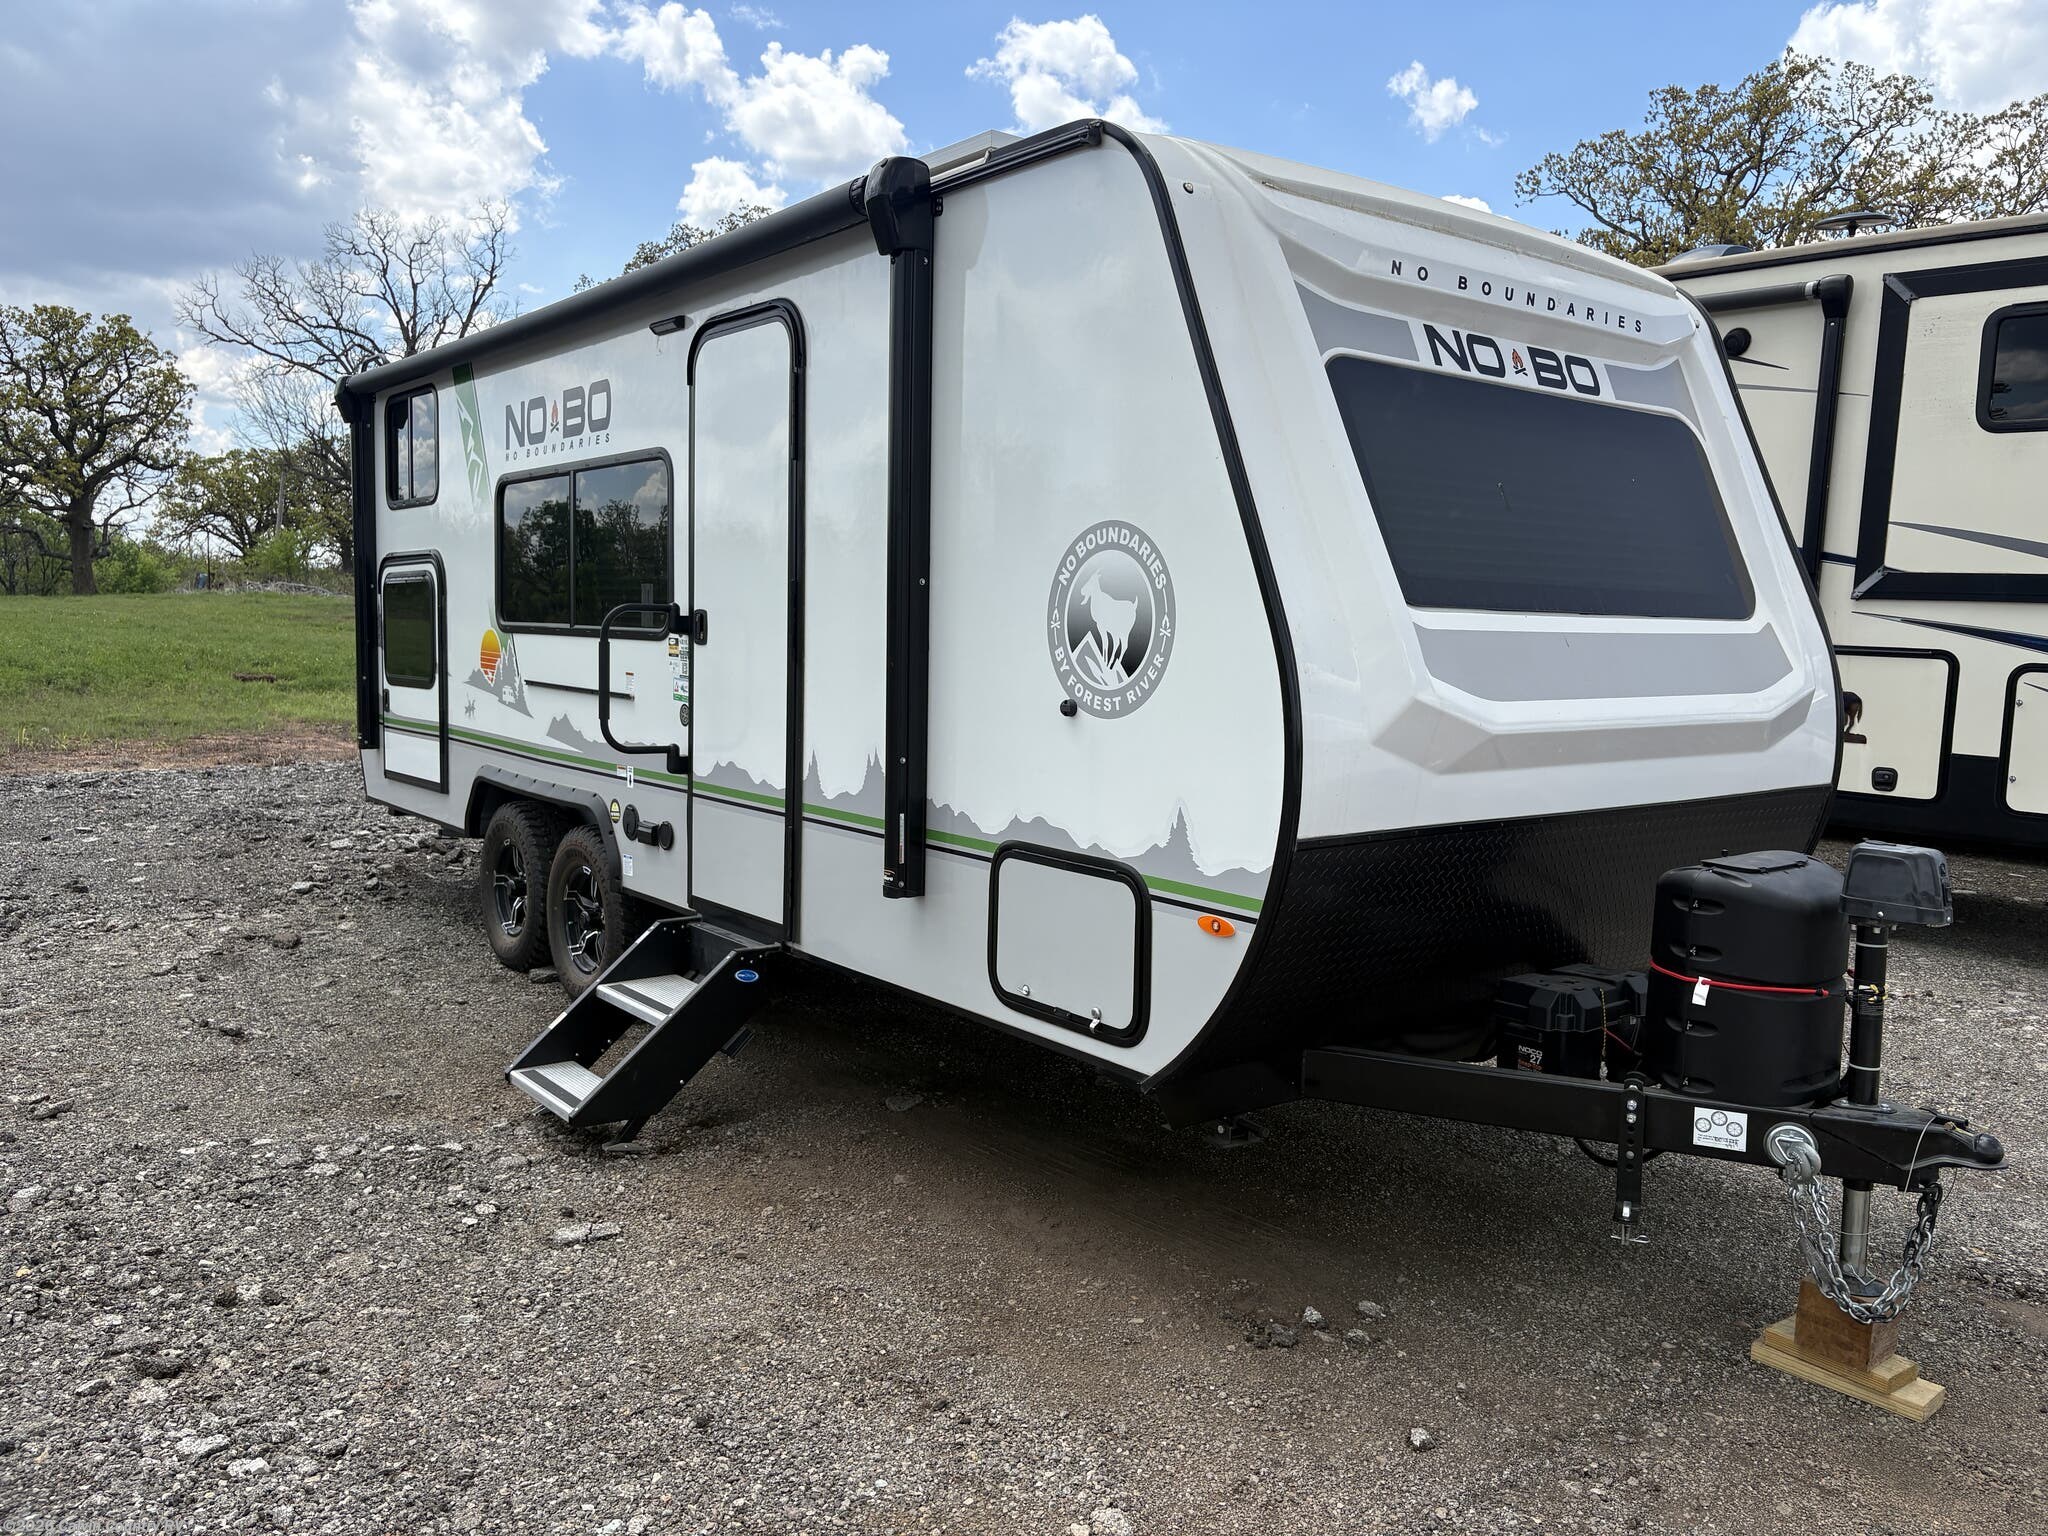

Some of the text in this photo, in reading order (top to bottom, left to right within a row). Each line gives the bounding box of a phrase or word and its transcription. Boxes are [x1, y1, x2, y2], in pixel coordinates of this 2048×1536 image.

[1391, 259, 1642, 333] NO BOUNDARIES
[505, 432, 611, 462] NO BOUNDARIES
[1058, 526, 1167, 590] NO BOUNDARIES
[1054, 646, 1165, 712] BY FOREST RIVER
